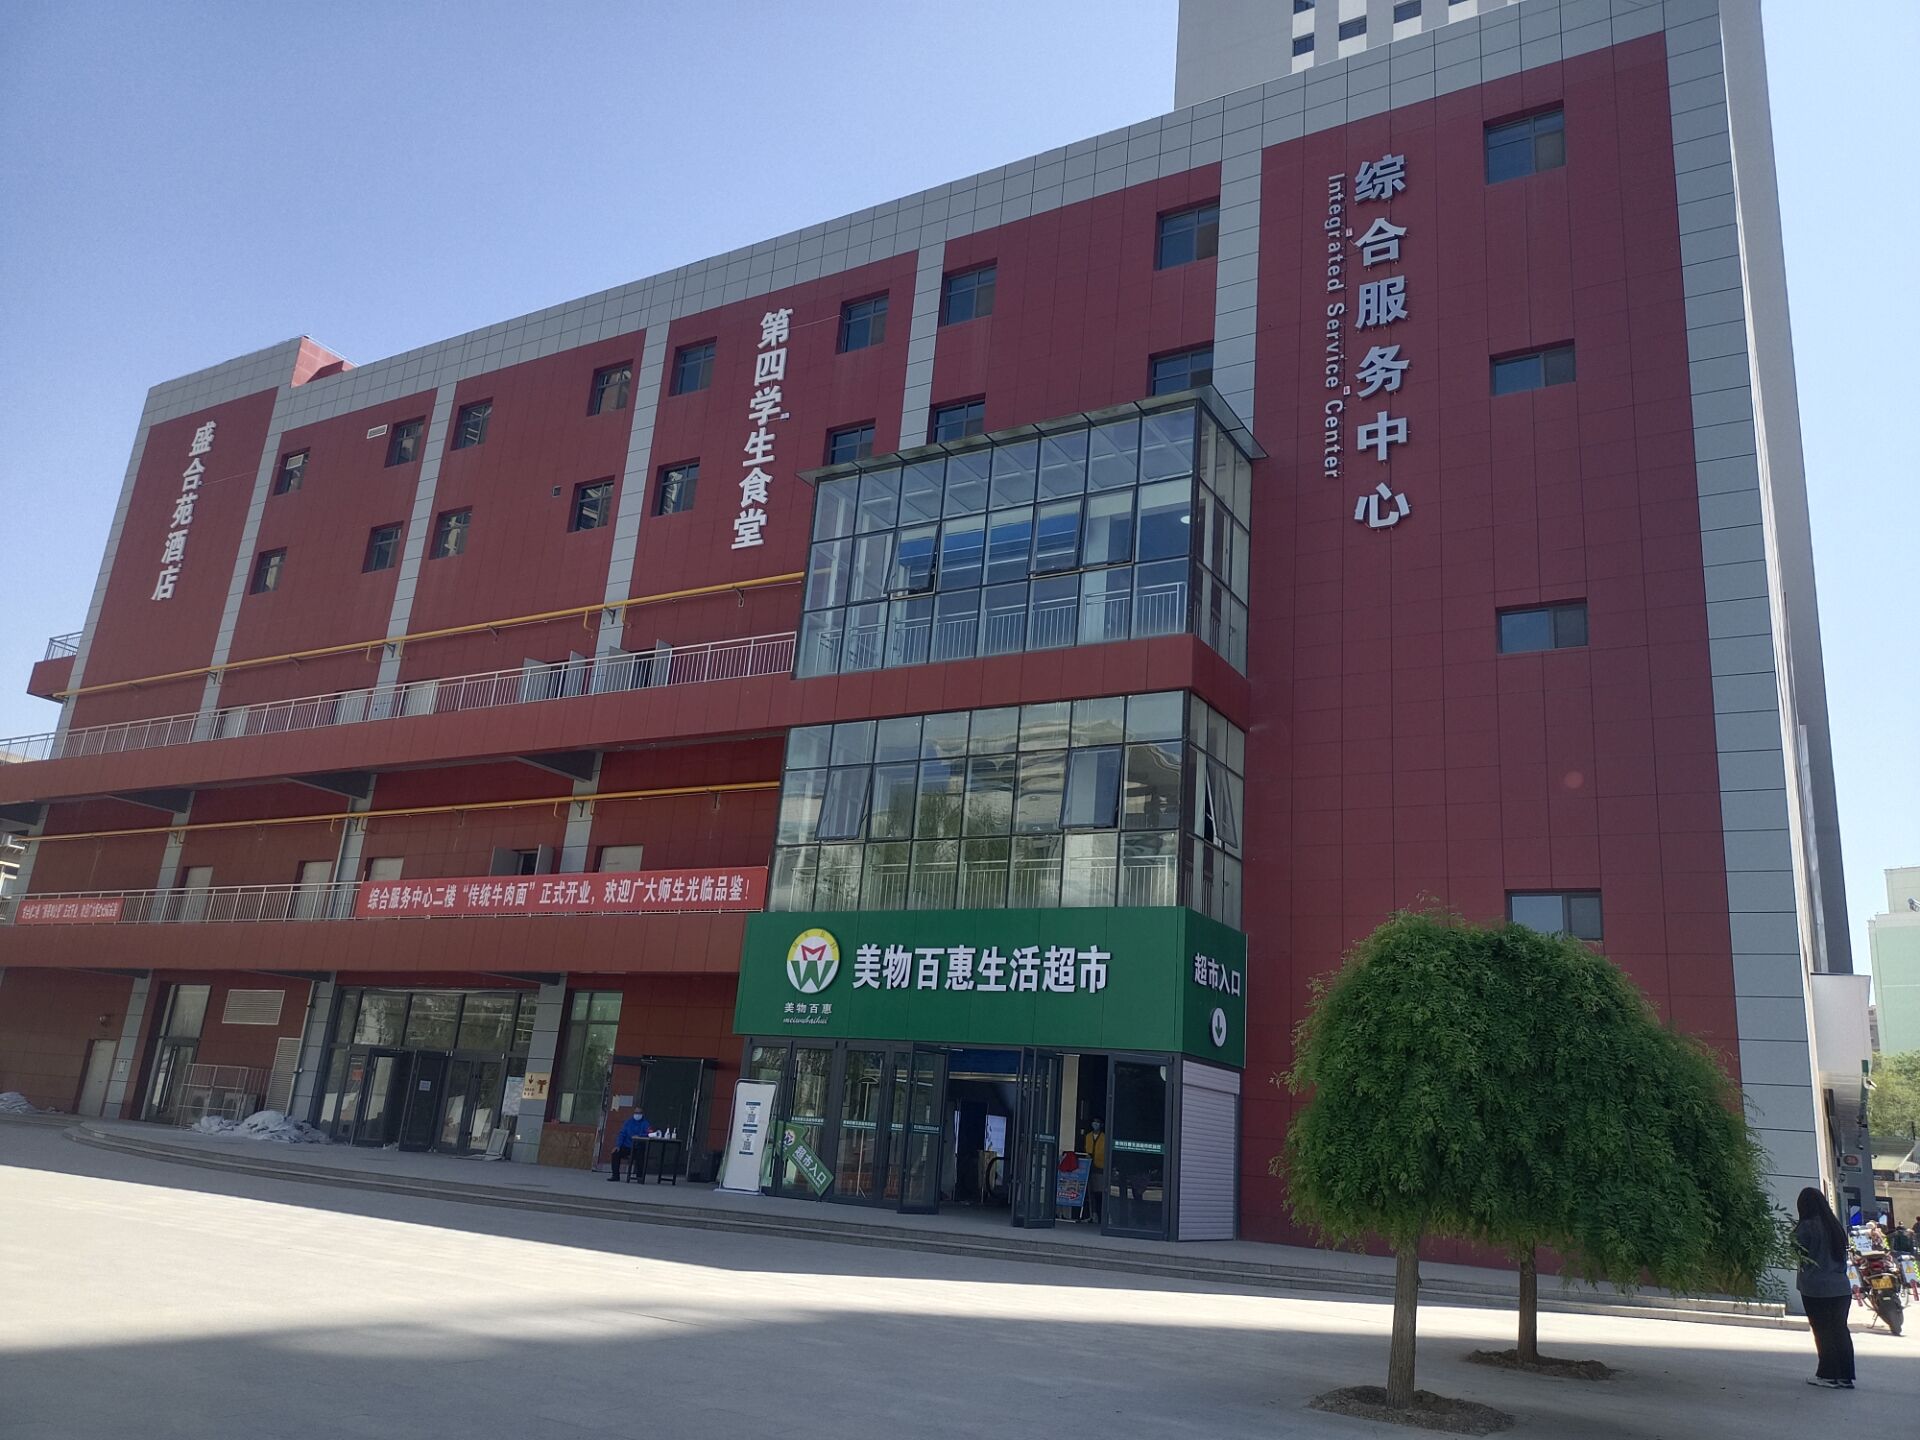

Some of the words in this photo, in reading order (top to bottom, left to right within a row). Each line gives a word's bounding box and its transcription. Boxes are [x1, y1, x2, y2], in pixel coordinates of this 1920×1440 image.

[1325, 172, 1346, 291] Integrated
[1325, 302, 1346, 389] Service
[1353, 153, 1411, 529] 综合服务中心
[731, 307, 794, 551] 第四学生食堂
[1323, 398, 1344, 479] Center
[150, 420, 216, 601] 盛合苑酒店
[783, 1002, 832, 1014] 美物百惠
[852, 943, 1111, 994] 美物百惠生活超市
[1194, 952, 1241, 998] 超市入口
[795, 1145, 827, 1185] 超市入口
